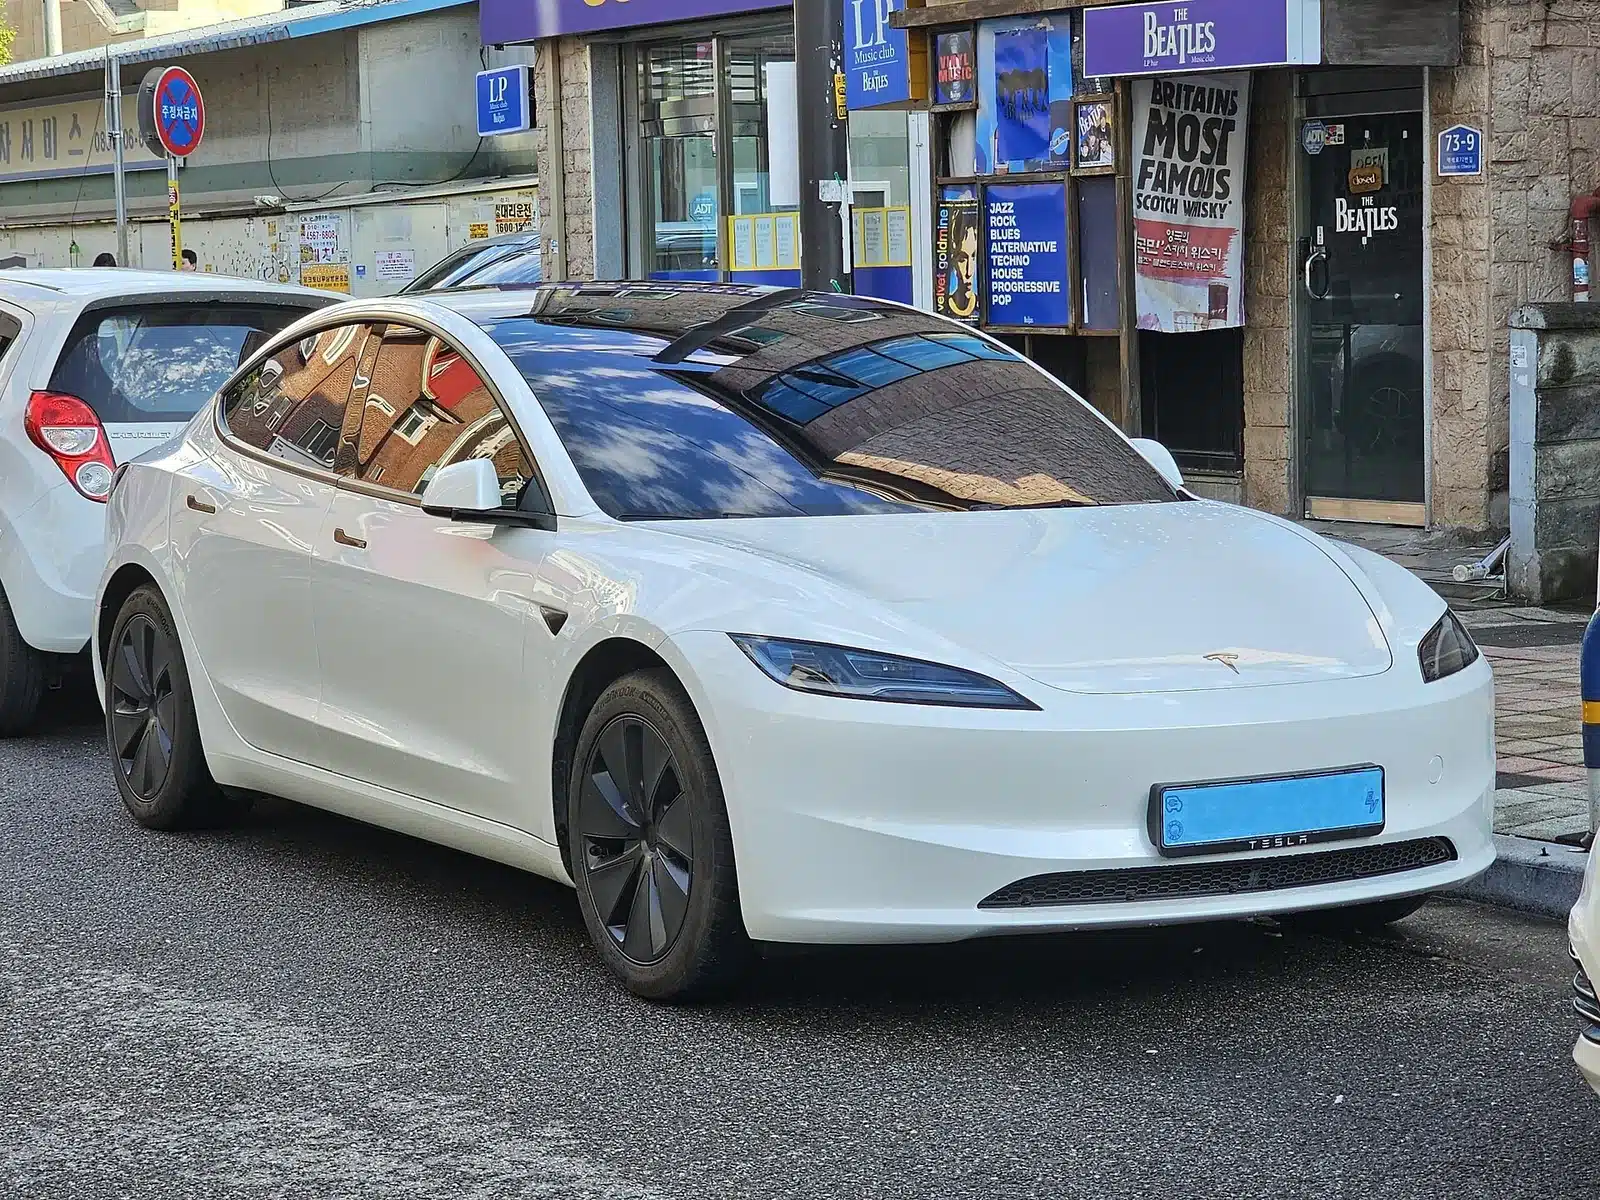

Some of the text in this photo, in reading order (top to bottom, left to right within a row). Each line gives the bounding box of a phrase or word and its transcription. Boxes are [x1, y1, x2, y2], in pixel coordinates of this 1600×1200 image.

[1174, 8, 1188, 21] THE
[851, 0, 893, 49] LP
[1143, 11, 1216, 64] BEATLES
[854, 44, 895, 64] Music club
[940, 53, 969, 69] VINYL
[938, 66, 972, 83] MUSIC
[488, 76, 508, 103] LP
[1150, 79, 1238, 116] BRITAINS
[162, 105, 198, 121] 주정차금지
[1142, 107, 1236, 166] MOST
[1445, 133, 1475, 152] 73-9
[1137, 158, 1231, 200] FAMOUS
[1352, 173, 1376, 185] closed
[990, 202, 1014, 214] JAZZ
[1136, 193, 1178, 215] SCOTCH
[1361, 196, 1374, 206] THE
[693, 203, 713, 215] ADT
[990, 215, 1016, 227] ROCK
[1335, 197, 1398, 238] BEATLES
[990, 229, 1021, 240] BLUES
[1165, 229, 1190, 244] 영국의
[991, 241, 1057, 253] ALTERNATIVE
[1190, 246, 1222, 260] 위스키
[936, 208, 949, 312] velvet goldmine
[991, 255, 1030, 266] TECHNO
[991, 268, 1023, 279] HOUSE
[992, 281, 1060, 293] PROGRESSIVE
[992, 294, 1012, 306] POP
[111, 431, 171, 439] CHEVROLET
[1248, 834, 1307, 850] TESLA
